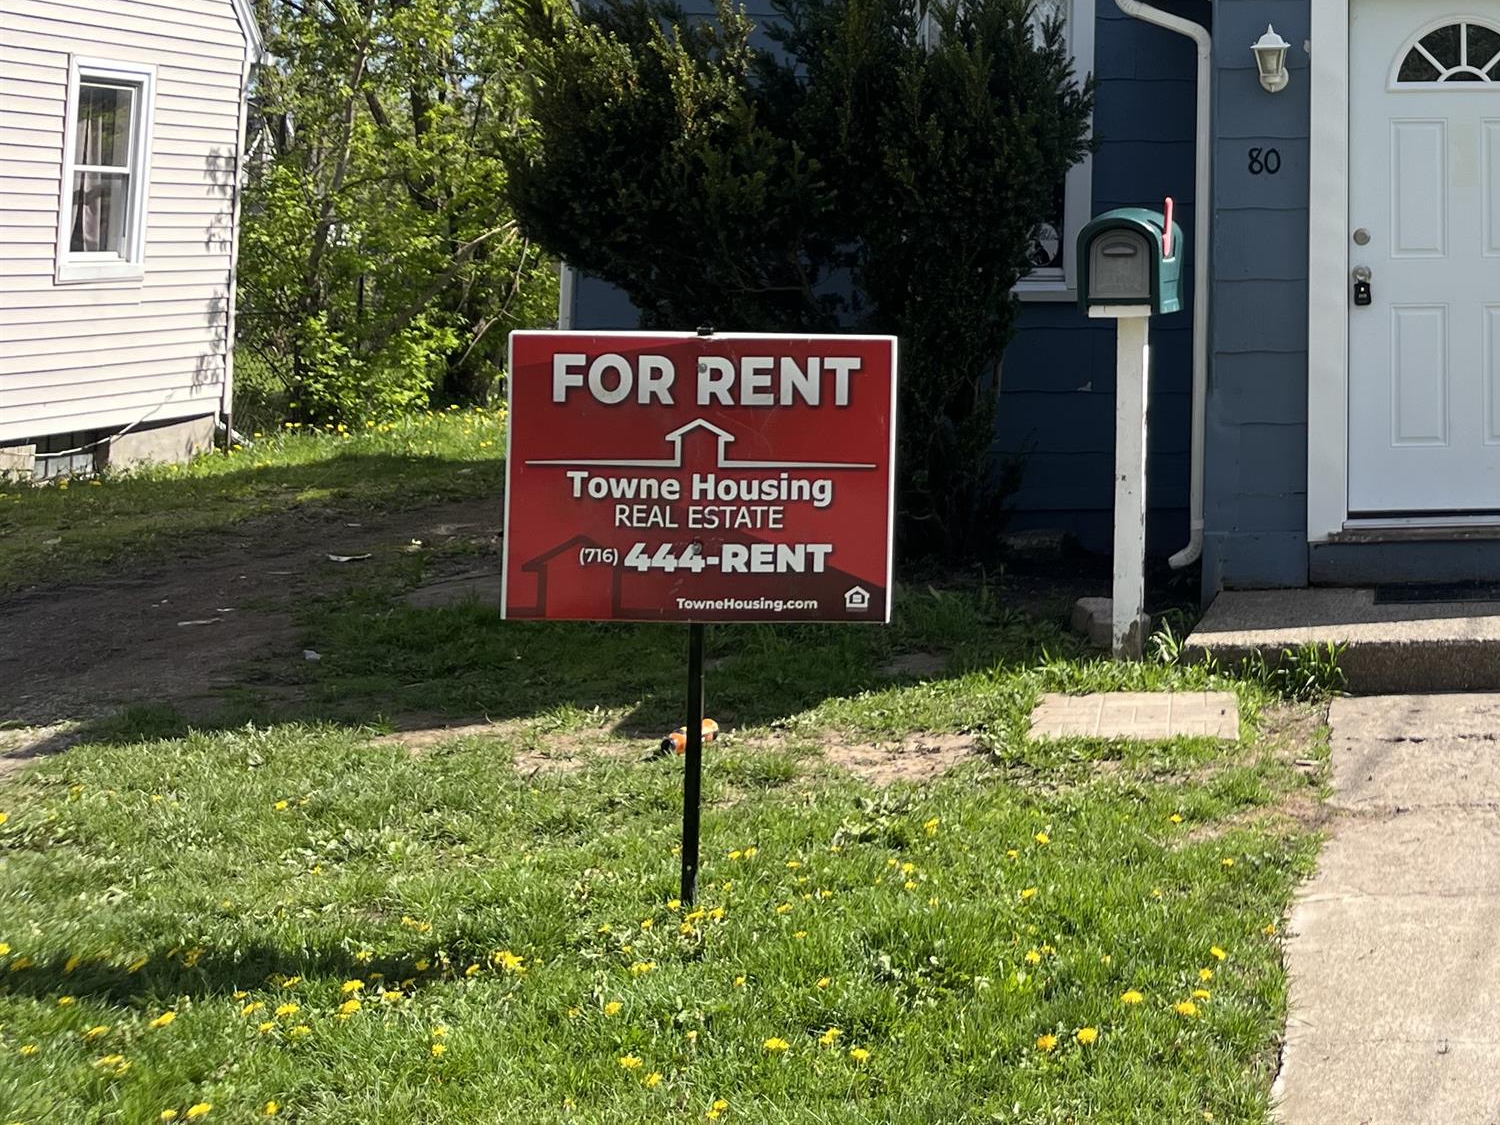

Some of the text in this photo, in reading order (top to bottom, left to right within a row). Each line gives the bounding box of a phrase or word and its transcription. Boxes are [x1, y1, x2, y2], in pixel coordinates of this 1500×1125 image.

[1248, 147, 1281, 175] 80
[552, 353, 861, 406] FOR RENT
[566, 471, 833, 507] Towne Housing
[614, 505, 784, 529] REAL ESTATE
[579, 542, 833, 573] (716) 444-RENT
[676, 597, 818, 611] TowneHousing.com
